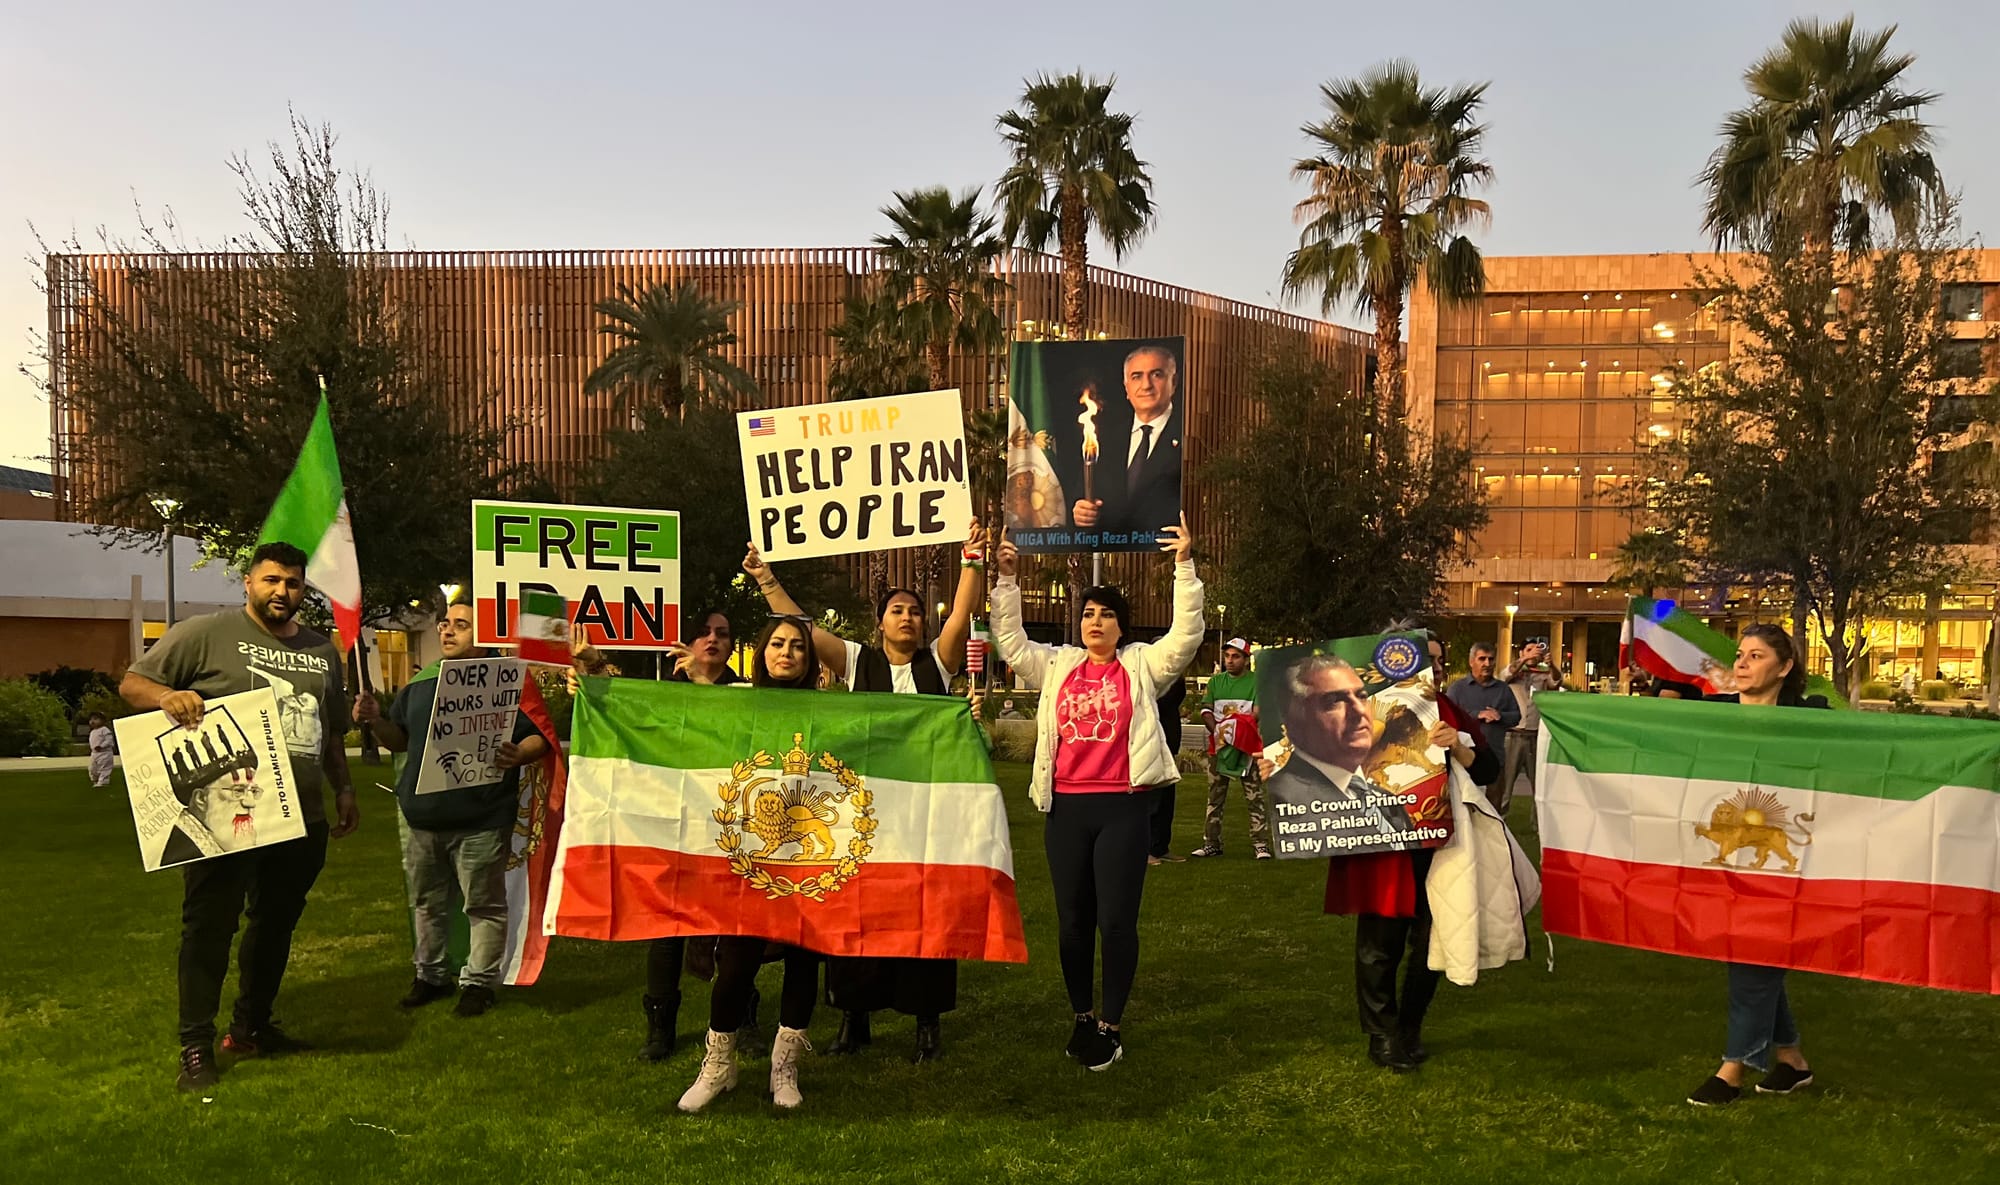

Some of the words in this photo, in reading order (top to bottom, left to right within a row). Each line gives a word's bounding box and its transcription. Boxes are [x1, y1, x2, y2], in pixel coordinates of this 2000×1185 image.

[799, 406, 900, 439] TRUMP
[756, 446, 852, 498] HELP
[871, 438, 964, 486] IRAN
[761, 490, 946, 552] PEOPLE
[494, 514, 662, 573] FREE
[1015, 533, 1044, 546] MIGA
[1047, 531, 1071, 545] With
[1074, 531, 1099, 548] King
[1102, 531, 1128, 544] Reza
[446, 664, 488, 688] OVER
[496, 664, 518, 687] 100
[436, 695, 484, 717] HOURS
[491, 689, 521, 707] WITH
[260, 709, 276, 750] REPUBLIC
[432, 721, 453, 741] NO
[458, 710, 517, 735] INTERNET
[478, 734, 502, 752] BE
[130, 763, 153, 789] NO
[270, 751, 284, 789] ISLAMIC
[136, 784, 175, 820] ISLAMIC
[278, 791, 287, 803] TO
[282, 804, 291, 818] NO
[1276, 803, 1307, 816] The
[1310, 798, 1362, 814] Crown
[1365, 793, 1417, 807] Prince
[139, 800, 182, 841] REPUBLIC
[1278, 821, 1317, 835] Reza
[1321, 813, 1378, 831] Pahlavi
[1280, 839, 1296, 853] Is
[1299, 836, 1322, 853] My
[1326, 826, 1448, 850] Representative
